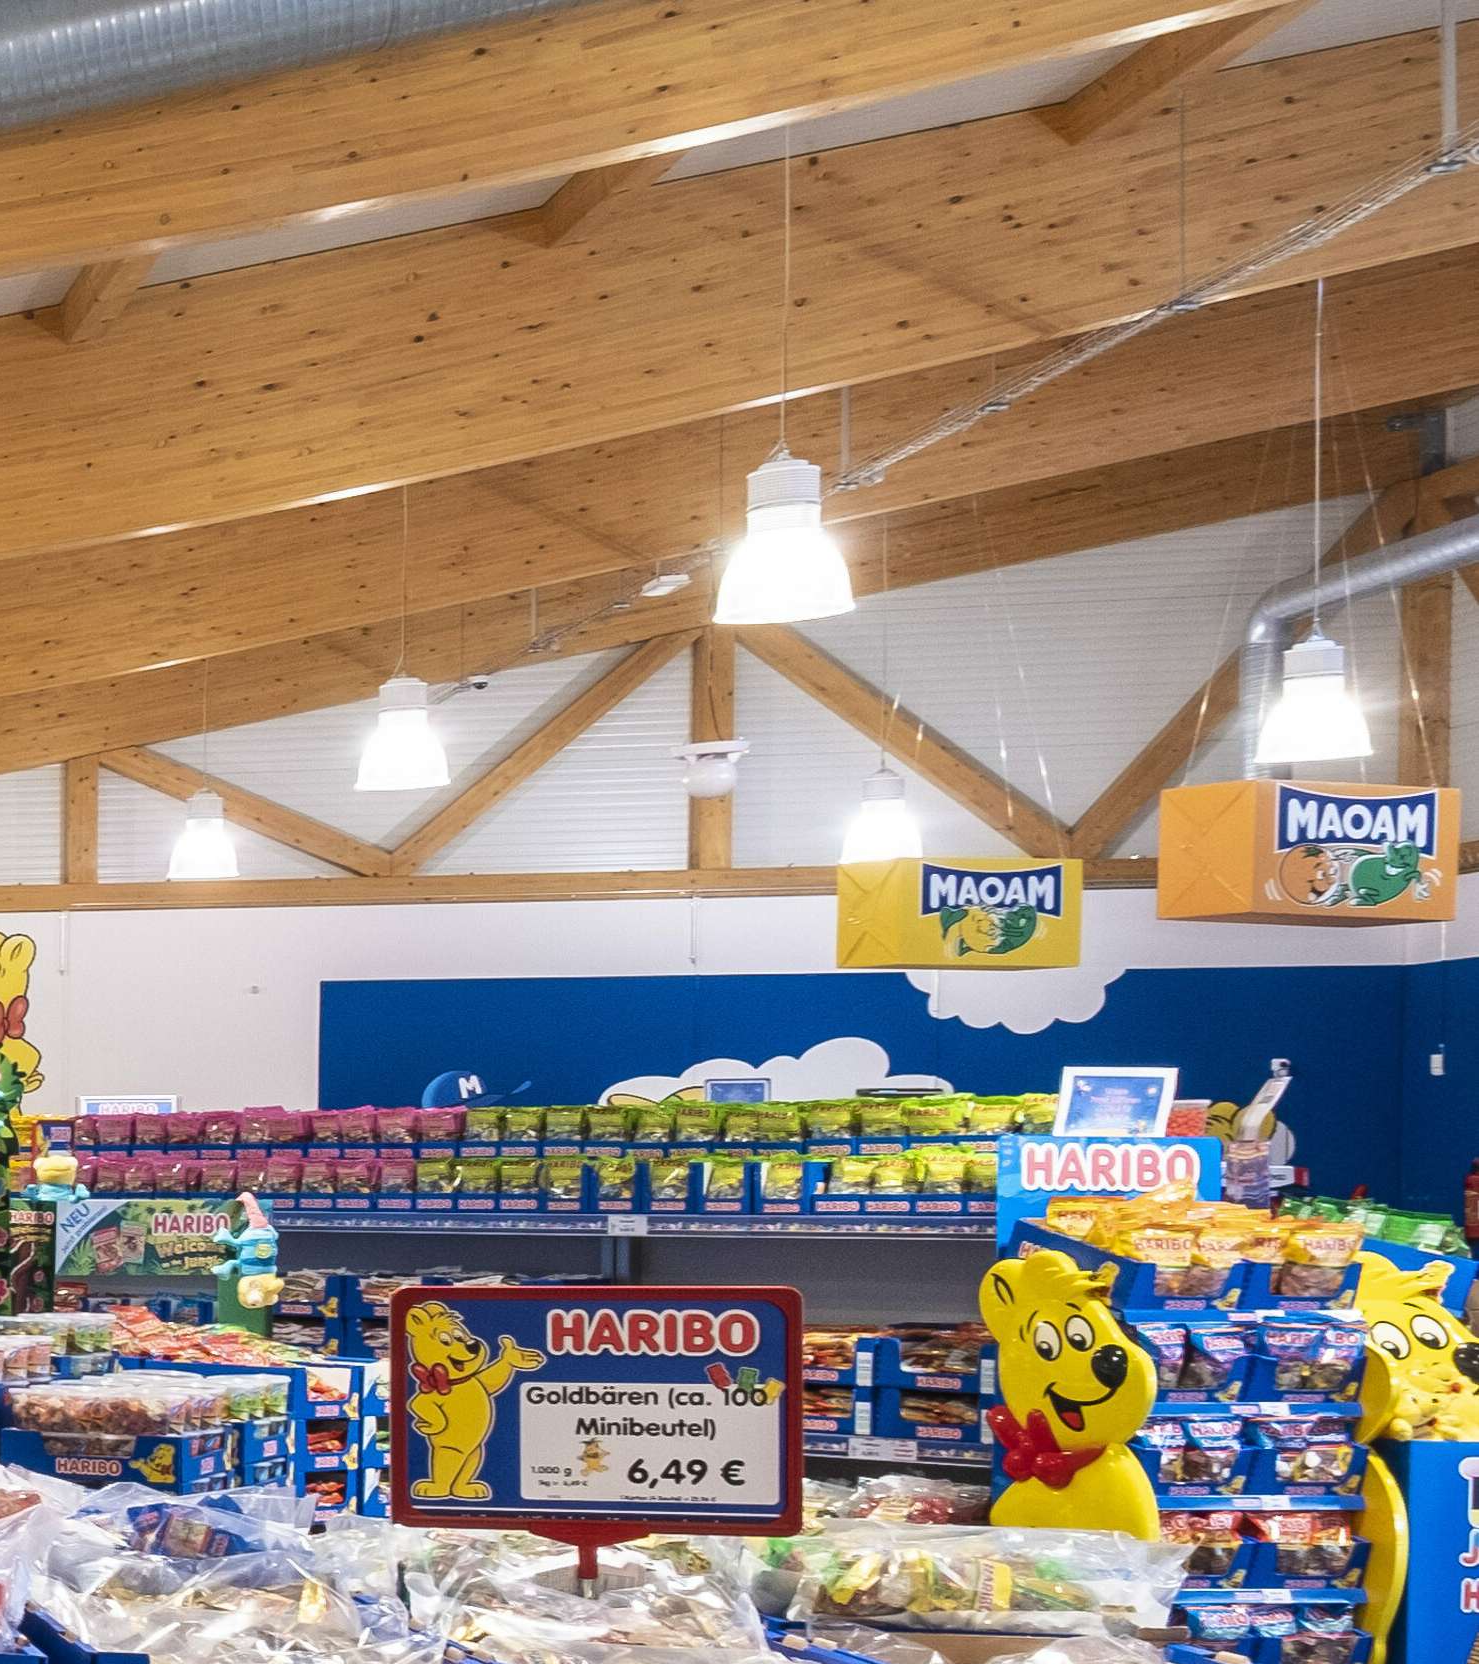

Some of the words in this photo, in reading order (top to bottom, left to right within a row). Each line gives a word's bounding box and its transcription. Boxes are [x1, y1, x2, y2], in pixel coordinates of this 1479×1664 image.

[1286, 798, 1427, 845] MAOAM
[929, 873, 1055, 909] MAOAM
[459, 1074, 483, 1099] M
[1024, 1144, 1197, 1192] HARIBO
[9, 1210, 53, 1224] HARIBO
[60, 1204, 91, 1233] NEU
[153, 1213, 230, 1236] HARIBO
[549, 1311, 758, 1354] HARIBO
[526, 1386, 658, 1407] Goldbären
[667, 1387, 712, 1409] (ca.
[721, 1387, 766, 1408] 100
[575, 1416, 716, 1441] Minibeutel)
[915, 1426, 962, 1439] HARIBO
[627, 1458, 708, 1489] 6,49
[720, 1460, 745, 1487] €
